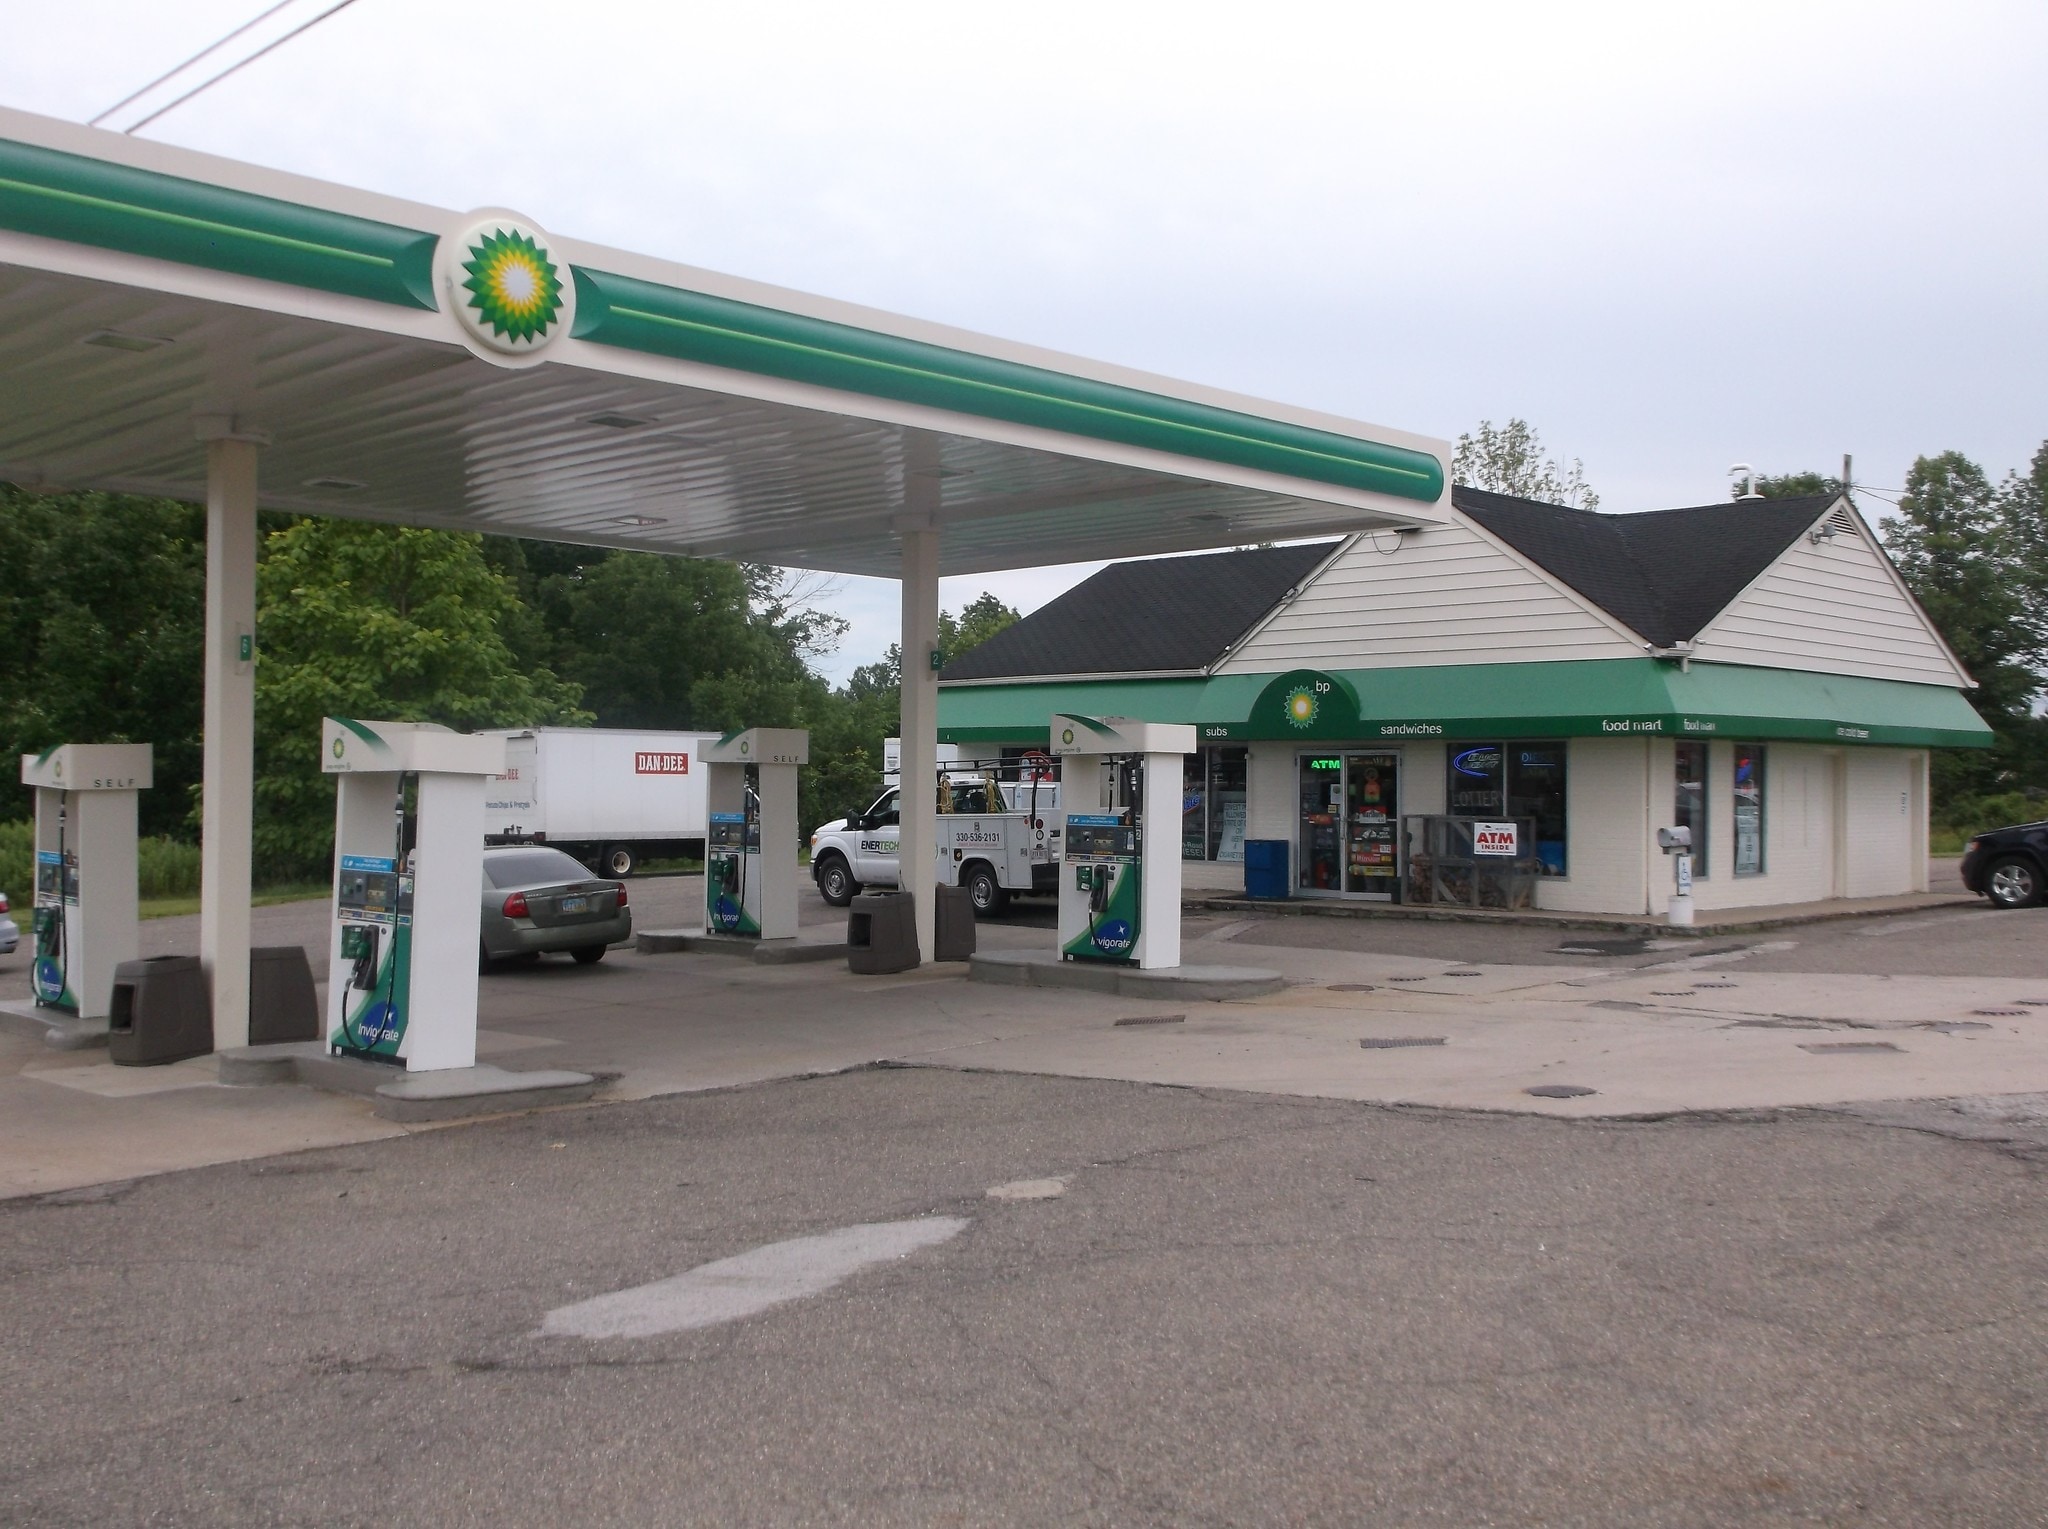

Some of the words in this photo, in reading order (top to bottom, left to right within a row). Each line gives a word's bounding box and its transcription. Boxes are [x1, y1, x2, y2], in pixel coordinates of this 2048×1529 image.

[933, 653, 939, 665] 2
[1315, 680, 1330, 694] bp
[1380, 724, 1442, 735] sandwiches
[1602, 719, 1629, 731] food
[1633, 719, 1662, 731] mart
[1683, 718, 1700, 730] food
[1205, 726, 1228, 736] subs
[1311, 760, 1341, 769] ATM
[94, 779, 135, 788] SELF
[956, 832, 1000, 842] 330-536-2131
[1477, 832, 1514, 844] ATM
